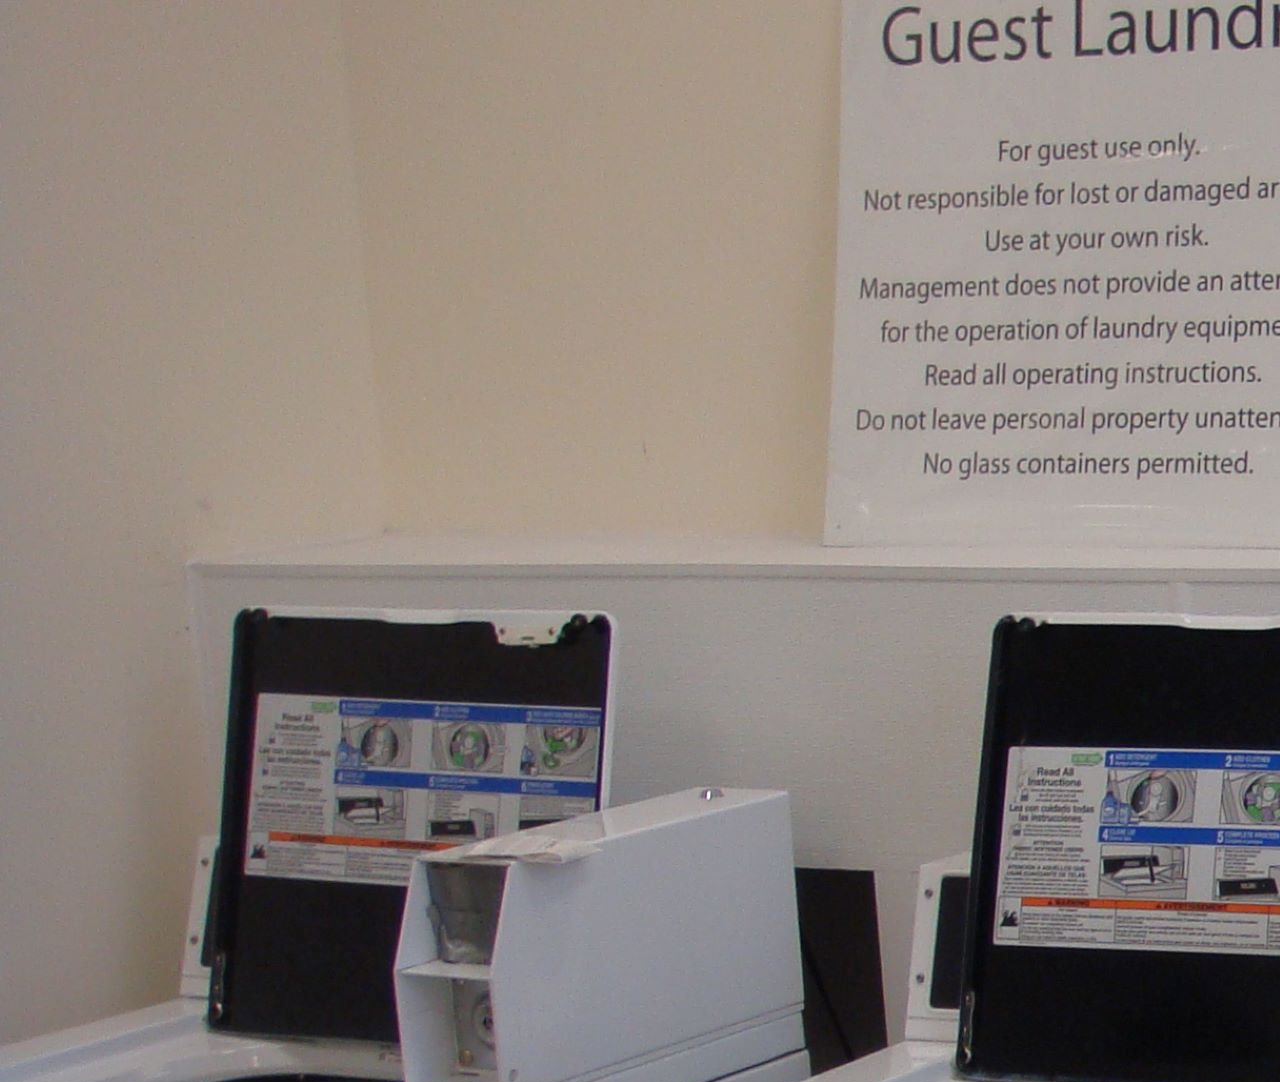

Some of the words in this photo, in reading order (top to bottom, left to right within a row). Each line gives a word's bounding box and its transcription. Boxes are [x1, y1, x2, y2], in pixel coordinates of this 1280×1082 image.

[882, 6, 1053, 66] Guest
[998, 140, 1033, 162] For
[1037, 139, 1099, 167] guest
[1104, 140, 1142, 159] use
[1147, 131, 1201, 162] only.
[864, 189, 902, 212] Not
[907, 183, 1029, 215] responsible
[1034, 182, 1065, 206] for
[1070, 181, 1110, 205] lost
[1115, 185, 1140, 204] or
[1144, 175, 1251, 207] damaged
[985, 229, 1024, 252] Use
[1029, 230, 1051, 251] at
[1055, 232, 1106, 257] your
[1110, 230, 1159, 249] own
[1165, 223, 1209, 247] risk.
[859, 277, 1000, 305] Management
[1005, 272, 1057, 296] does
[1063, 274, 1101, 295] not
[1106, 268, 1191, 300] provide
[1196, 274, 1224, 292] an
[880, 319, 910, 343] for
[914, 319, 949, 343] the
[954, 318, 1059, 347] operation
[1065, 315, 1089, 340] of
[1093, 314, 1178, 344] laundry
[925, 362, 977, 387] Read
[982, 362, 1007, 386] all
[1012, 362, 1119, 391] operating
[1125, 360, 1262, 384] instructions.
[856, 408, 885, 431] Do
[891, 410, 927, 431] not
[931, 407, 987, 431] leave
[992, 406, 1085, 436] personal
[1091, 408, 1190, 435] property
[923, 452, 953, 475] No
[958, 451, 1011, 481] glass
[1016, 452, 1130, 475] containers
[1136, 450, 1254, 481] permitted.
[1037, 767, 1061, 777] Read
[1062, 767, 1075, 777] All
[1224, 755, 1232, 767] 2
[1027, 777, 1082, 787] Instructions
[1102, 828, 1109, 841] 4
[1217, 831, 1224, 843] 5
